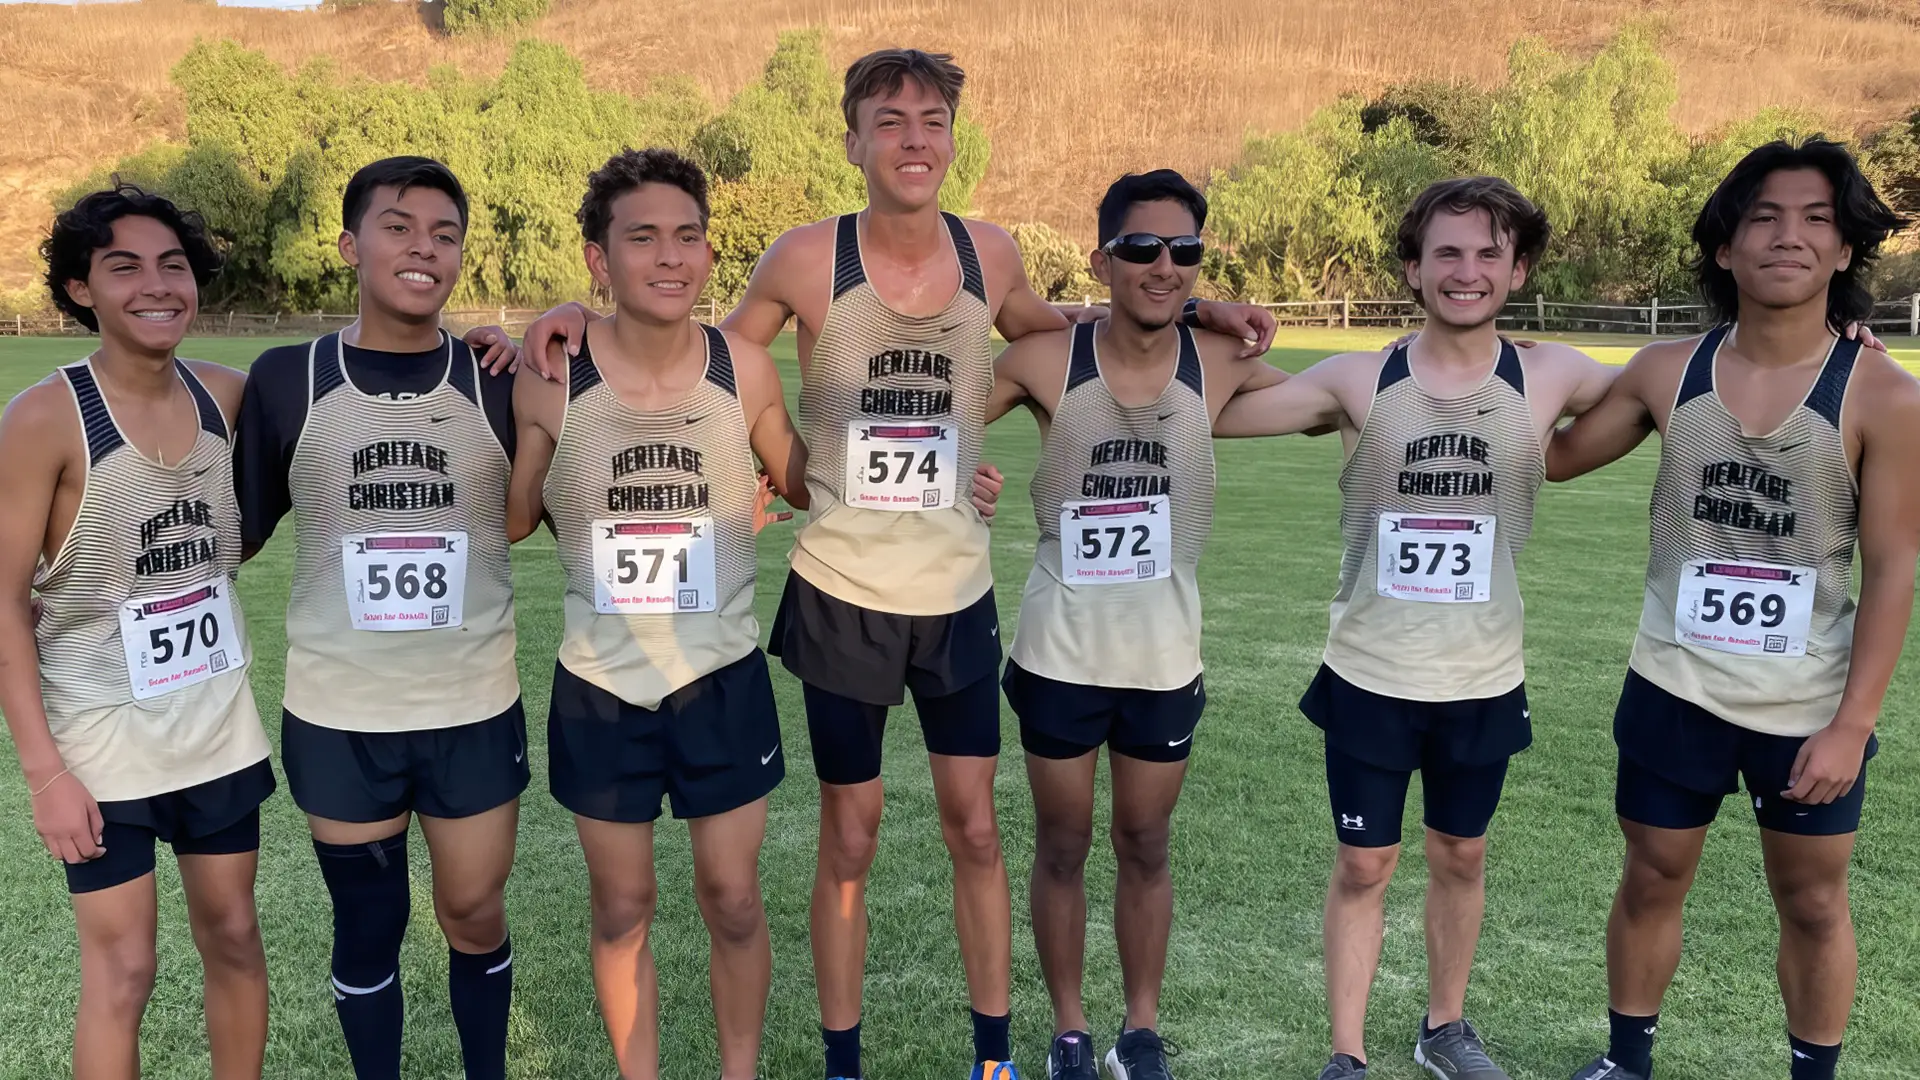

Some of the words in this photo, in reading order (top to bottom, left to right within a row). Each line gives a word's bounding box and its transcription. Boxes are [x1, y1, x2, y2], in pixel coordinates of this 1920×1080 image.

[353, 441, 449, 478] HERITAGE
[612, 443, 704, 482] HERITAGE
[1090, 438, 1169, 468] HERITAGE
[1405, 433, 1489, 466] HERITAGE
[868, 450, 940, 484] 574
[1398, 471, 1494, 496] CHRISTIAN
[349, 482, 455, 510] CHRISTIAN
[607, 483, 709, 512] CHRISTIAN
[1081, 473, 1171, 498] CHRISTIAN
[1081, 524, 1152, 560] 572
[1398, 542, 1471, 576] 573
[367, 562, 449, 601] 568
[616, 547, 688, 584] 571
[1700, 587, 1787, 628] 569
[149, 612, 219, 665] 570
